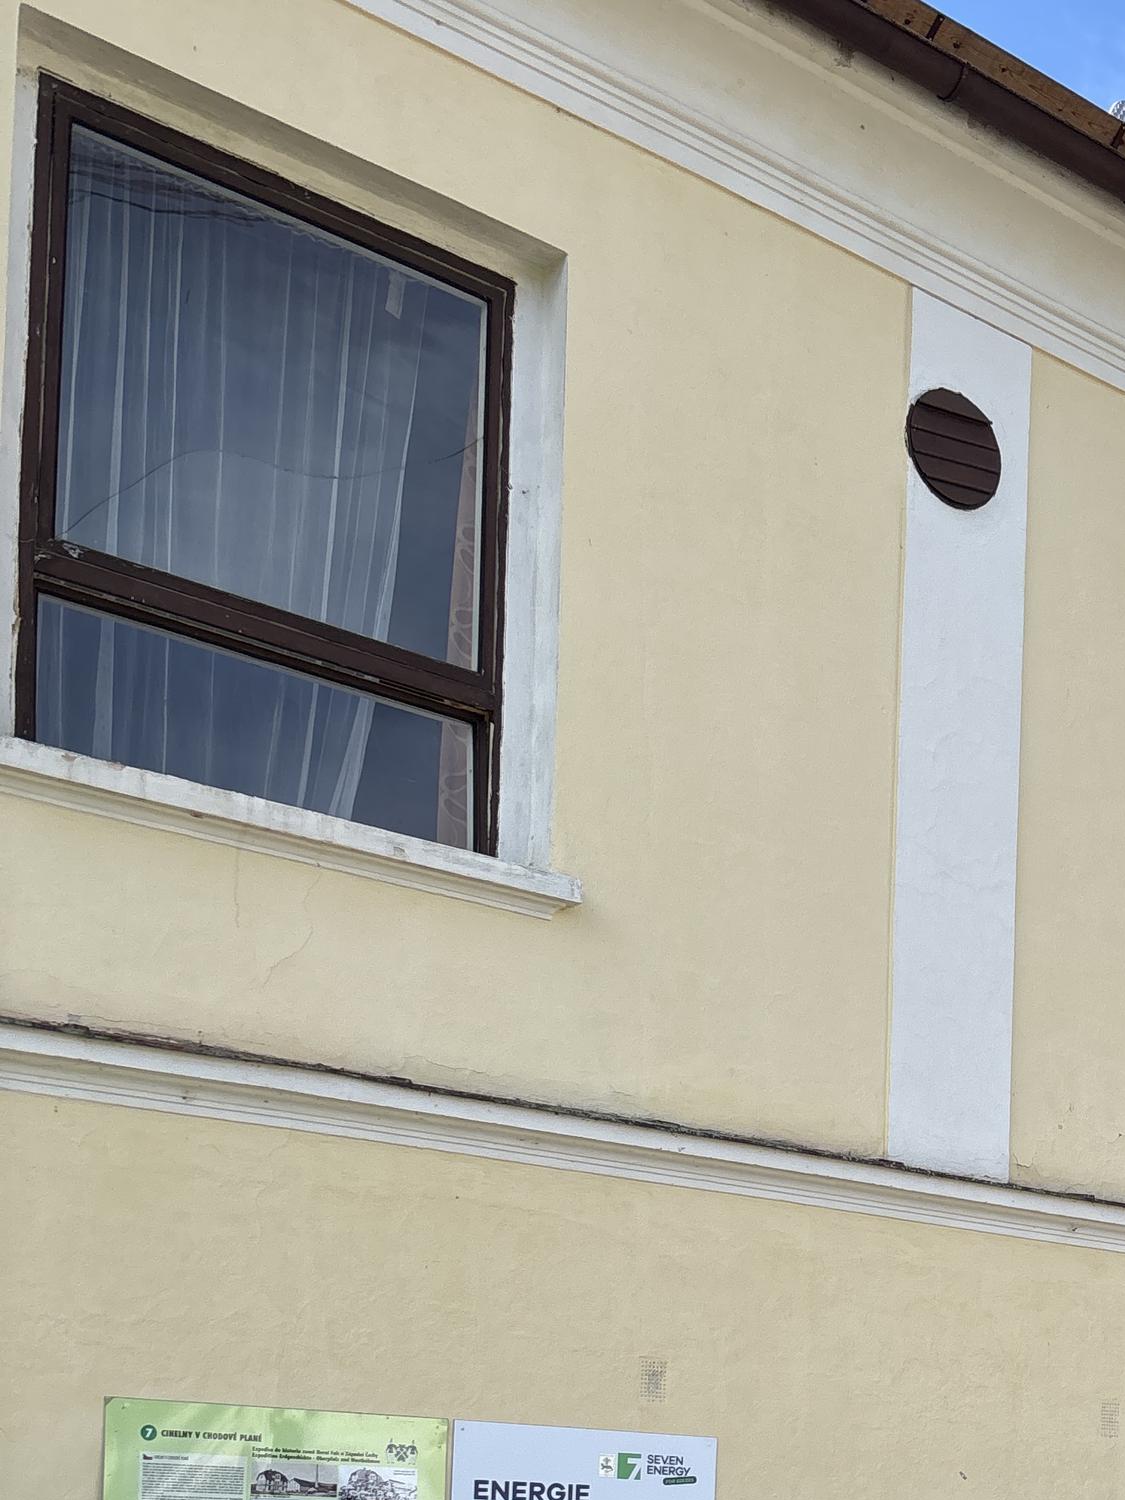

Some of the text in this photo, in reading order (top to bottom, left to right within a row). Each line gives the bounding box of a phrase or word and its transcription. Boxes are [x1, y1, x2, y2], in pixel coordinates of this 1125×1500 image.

[145, 1428, 154, 1438] 7
[195, 1431, 200, 1439] V
[202, 1431, 237, 1441] CHODOVÉ
[647, 1465, 691, 1476] ENERGY
